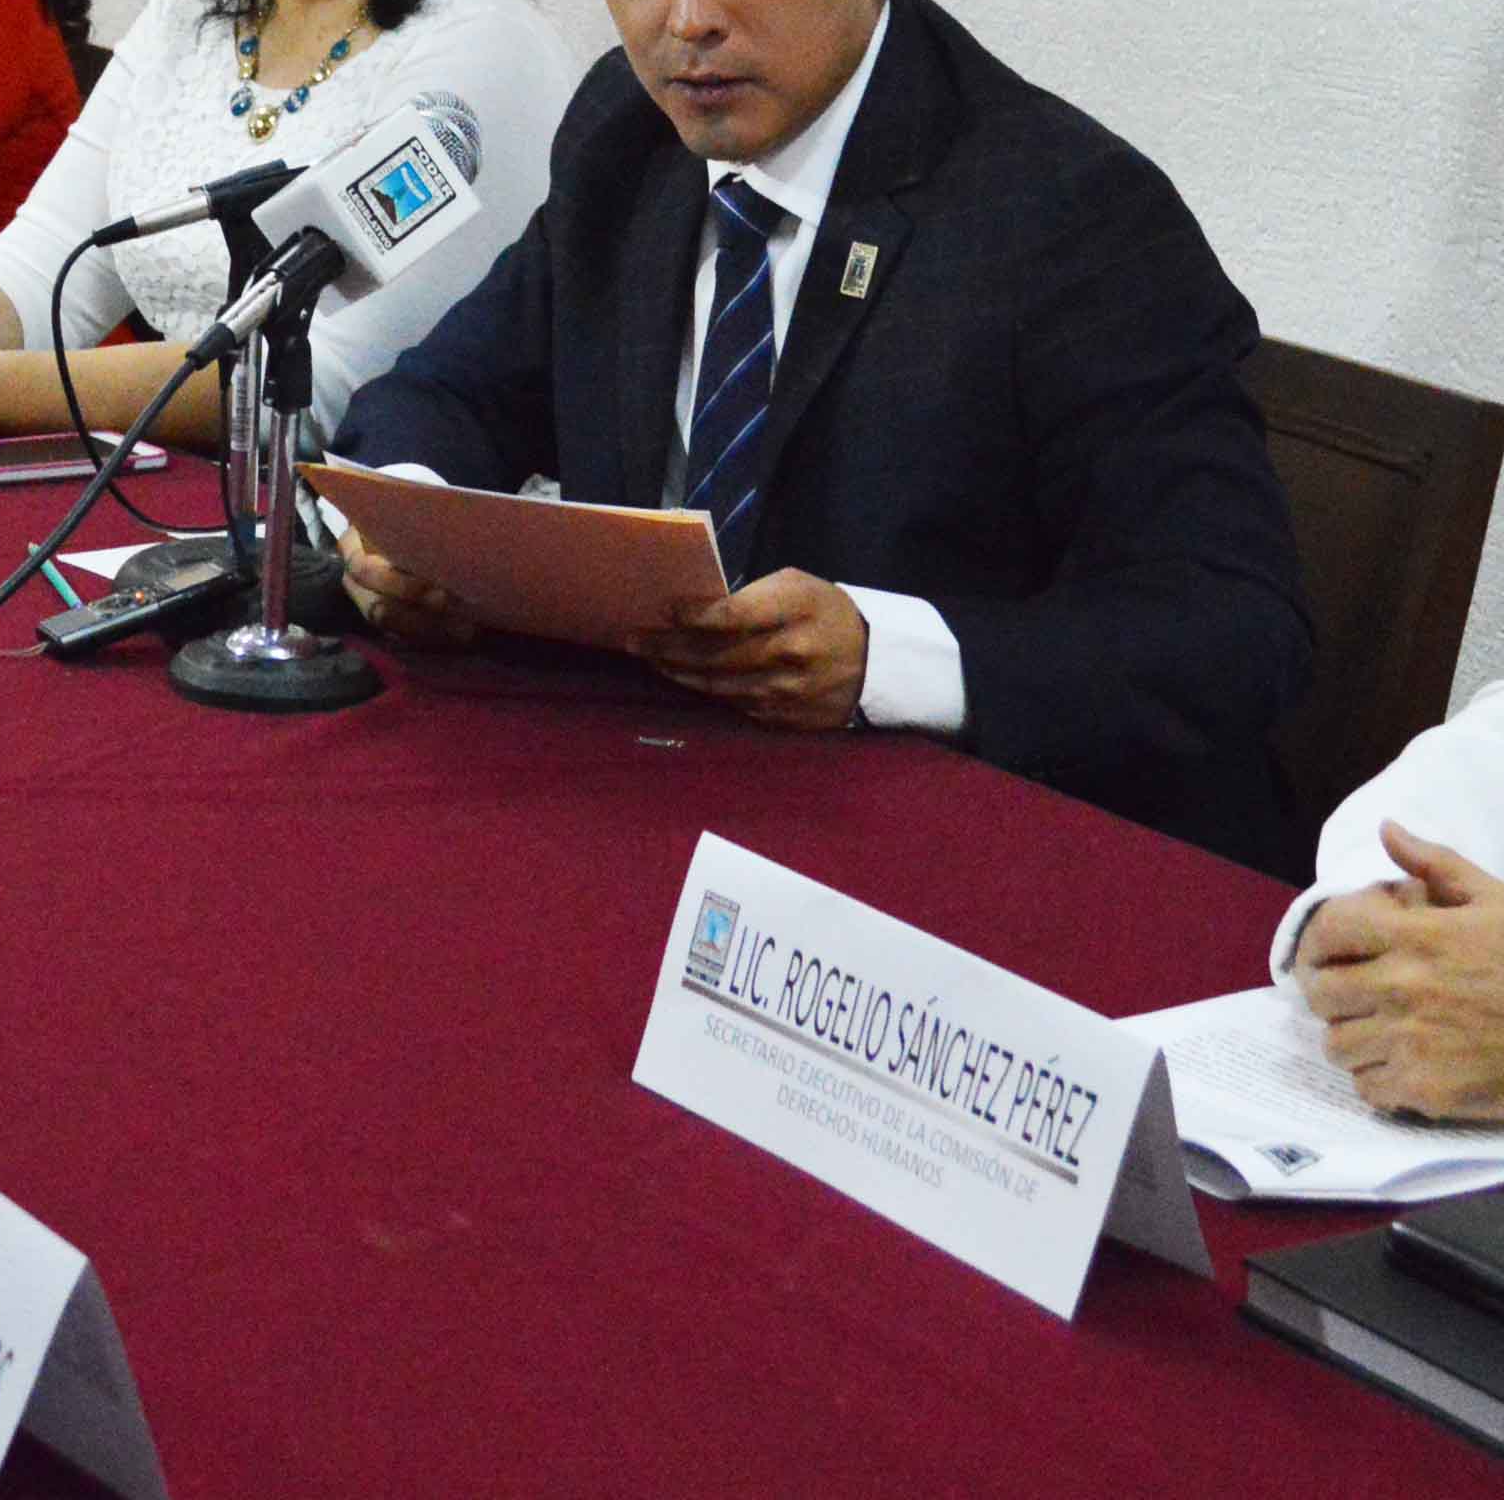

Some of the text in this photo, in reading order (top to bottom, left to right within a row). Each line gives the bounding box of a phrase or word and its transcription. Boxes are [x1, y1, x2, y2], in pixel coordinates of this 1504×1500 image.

[704, 1012, 797, 1077] SECRETARIO
[797, 1061, 881, 1121] EJECUTIVO
[881, 1107, 905, 1131] DE
[906, 1119, 927, 1146] LA
[729, 925, 776, 1009] LIC.
[777, 949, 892, 1062] ROGELIO
[888, 996, 1014, 1124] SÁNCHEZ
[1005, 1055, 1098, 1166] PÉREZ
[776, 1083, 946, 1190] DERECHOS HUMANOS
